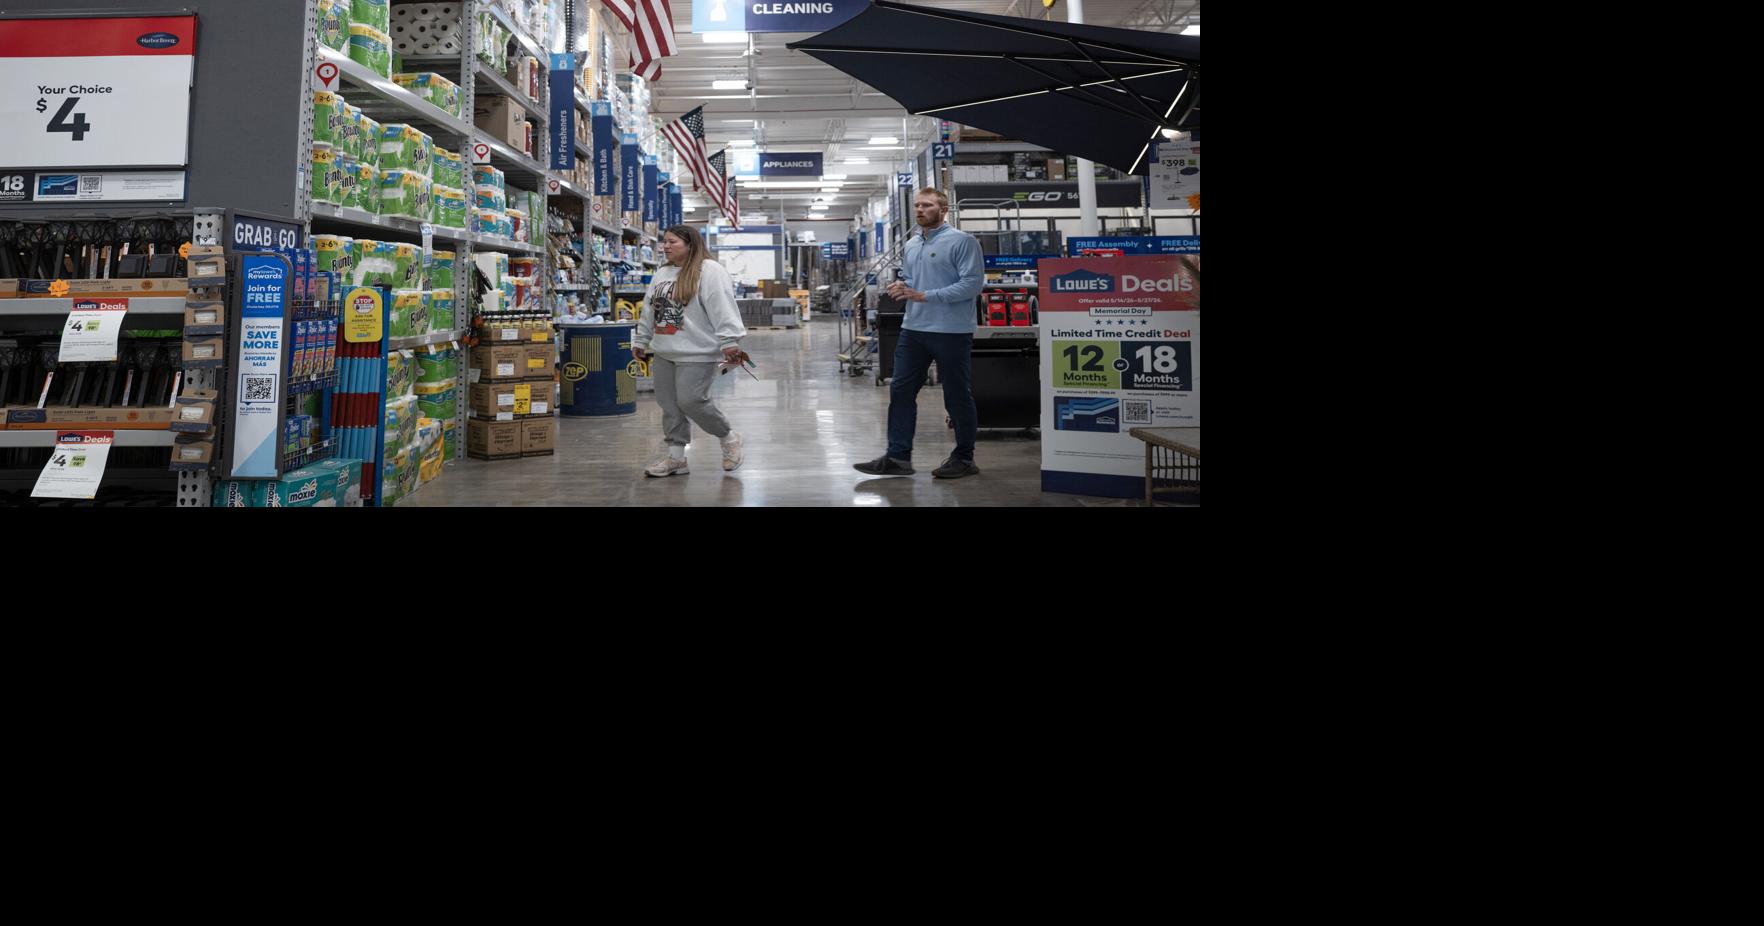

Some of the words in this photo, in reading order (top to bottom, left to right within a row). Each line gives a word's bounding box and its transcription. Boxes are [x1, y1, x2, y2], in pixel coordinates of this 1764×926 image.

[752, 3, 833, 14] CLEANING
[38, 85, 66, 95] Your
[69, 85, 113, 95] Choice
[558, 110, 567, 152] Fresheners
[935, 144, 952, 157] 21
[558, 154, 567, 166] Air
[1, 175, 24, 191] 18
[898, 175, 913, 185] 22
[1013, 192, 1062, 202] EGO
[235, 223, 272, 246] GRAB
[279, 228, 296, 250] GO
[1098, 241, 1138, 249] Assembly
[248, 272, 283, 280] Rewards
[247, 284, 265, 293] Join
[267, 284, 282, 293] for
[1056, 278, 1109, 290] LOWE'S
[1122, 275, 1193, 292] Deals
[247, 293, 281, 303] FREE
[247, 331, 277, 339] SAVE
[1051, 330, 1092, 338] Limited
[1095, 330, 1122, 338] Time
[1125, 330, 1162, 338] Credit
[1164, 330, 1191, 338] Deal
[243, 341, 278, 349] MORE
[1063, 345, 1104, 372] 12
[1135, 345, 1178, 374] 18
[1063, 373, 1107, 382] Months
[1134, 374, 1180, 383] Months
[84, 435, 111, 443] Deals
[229, 483, 237, 507] moxie
[290, 488, 317, 503] moxie
